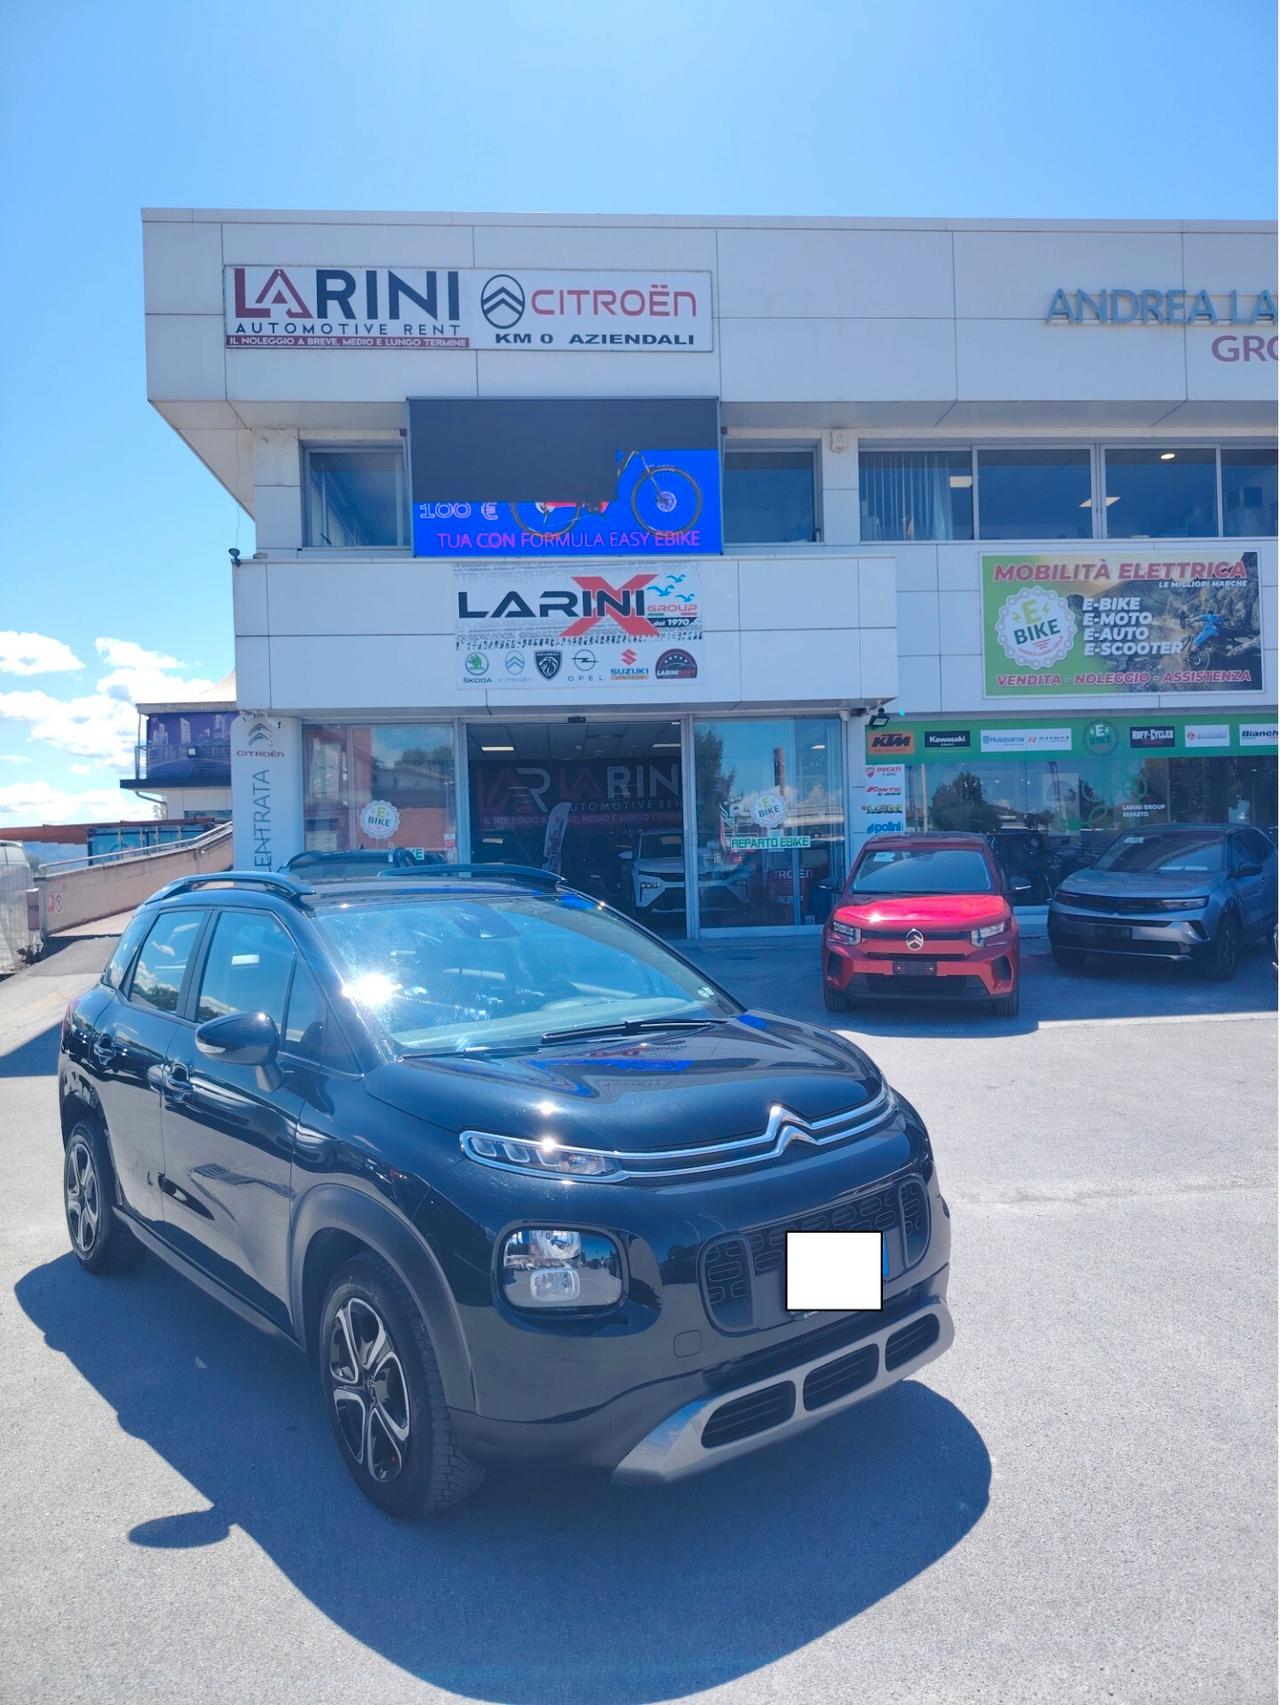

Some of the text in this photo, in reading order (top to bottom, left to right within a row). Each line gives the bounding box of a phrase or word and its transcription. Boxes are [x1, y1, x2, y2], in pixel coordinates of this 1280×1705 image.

[234, 268, 460, 321] LARINI
[1045, 288, 1218, 325] ANDREA
[236, 322, 461, 336] AUTOMOTIVE RENT
[230, 337, 239, 345] IL
[241, 337, 295, 345] NOLEGGIO
[342, 338, 374, 346] MEDIO
[376, 338, 383, 346] E
[385, 338, 421, 346] LUNGO
[424, 339, 467, 347] TERMINE
[495, 333, 531, 344] KM
[569, 334, 694, 345] AZIENDALI
[420, 502, 472, 519] 100
[437, 530, 701, 548] TUA CON FORMULA EASY EBIKE
[994, 559, 1248, 582] MOBILITÀ ELETTRICA
[458, 590, 645, 619] LARINI
[647, 604, 698, 612] GROUP
[1083, 597, 1142, 611] E-BIKE
[1022, 599, 1042, 624] E
[1083, 612, 1153, 626] E-MOTO
[1013, 618, 1061, 645] BIKE
[1083, 627, 1149, 641] E-AUTO
[1084, 642, 1184, 655] E-SCOOTER
[610, 667, 649, 675] SUZUKI
[997, 675, 1061, 686] VENDITA
[1074, 674, 1149, 684] NOLEGGIO
[1163, 671, 1252, 682] ASSISTENZA
[872, 733, 910, 747] KTM
[929, 735, 966, 743] Kawasaki
[571, 799, 653, 812] UTOMOTIVE
[758, 805, 780, 818] BIKE
[252, 769, 272, 867] ENTRATA
[367, 816, 391, 827] BIKE
[731, 838, 809, 848] REPARTO EBIKE
